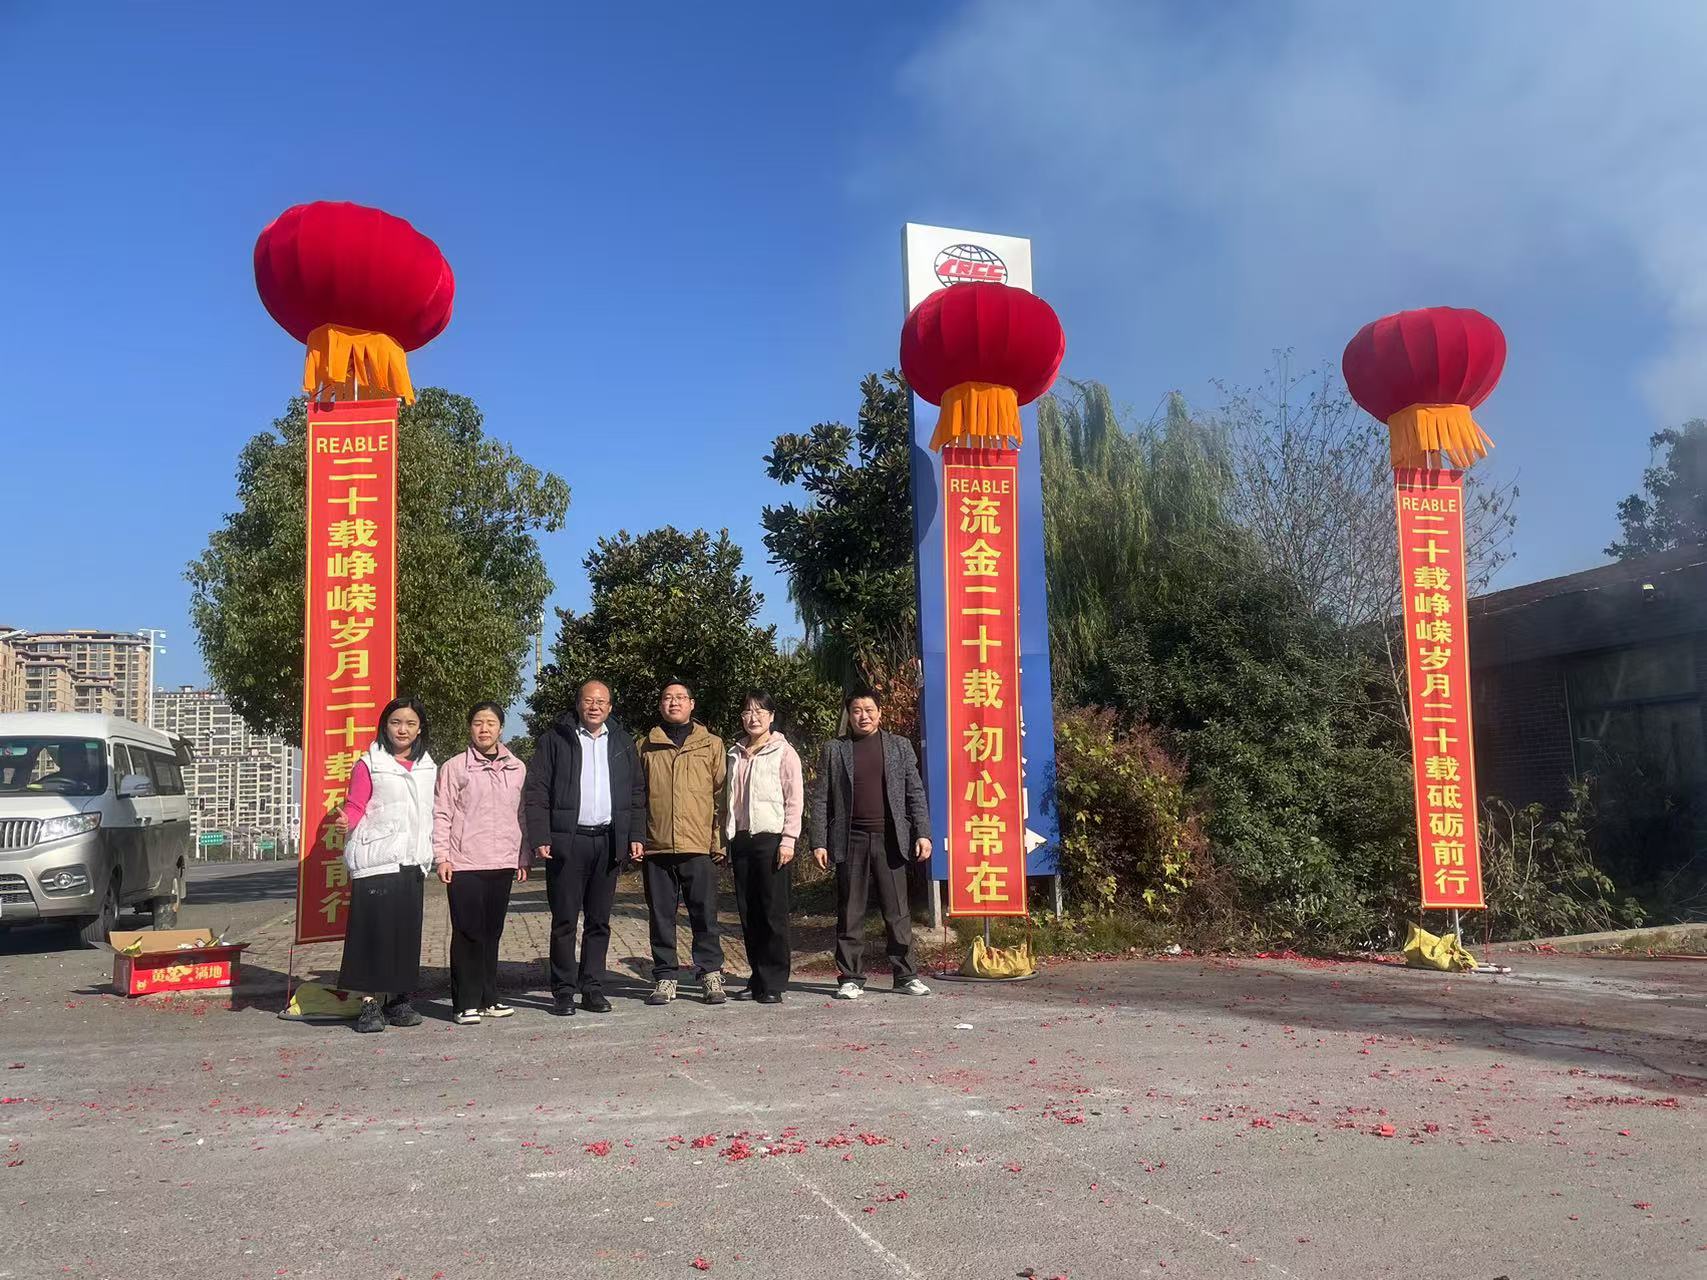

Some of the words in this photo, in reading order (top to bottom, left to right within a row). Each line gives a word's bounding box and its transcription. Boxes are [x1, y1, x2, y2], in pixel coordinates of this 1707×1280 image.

[316, 435, 389, 454] REABLE
[950, 478, 1010, 494] REABLE
[1401, 496, 1458, 513] REABLE
